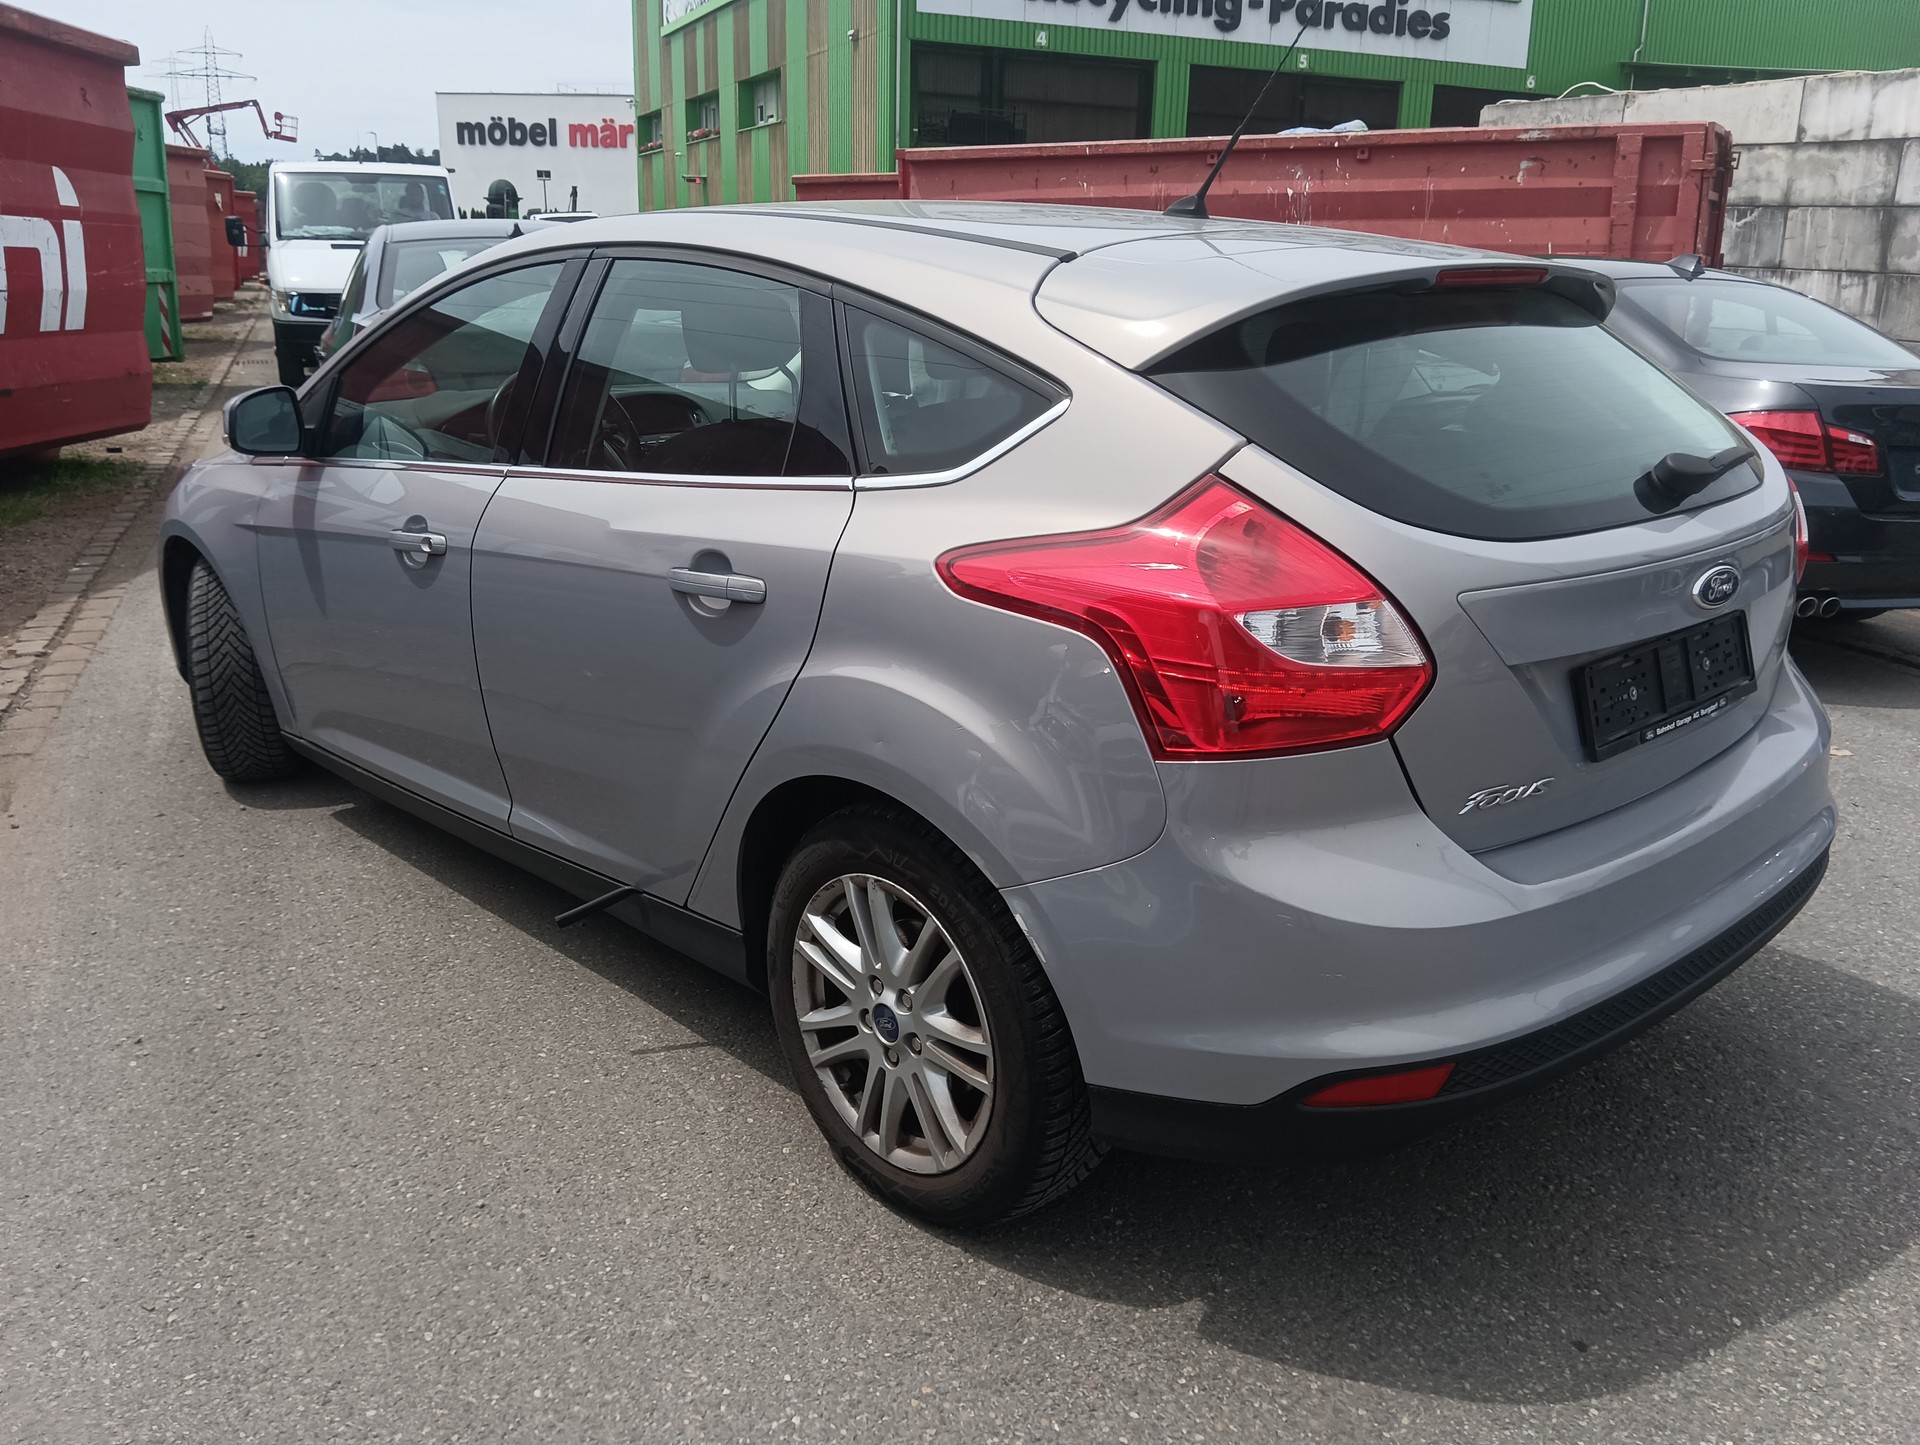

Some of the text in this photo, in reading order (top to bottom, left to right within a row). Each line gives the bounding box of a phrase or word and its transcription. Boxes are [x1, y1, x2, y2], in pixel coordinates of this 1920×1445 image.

[1036, 31, 1047, 46] 4
[1299, 55, 1307, 68] 5
[1526, 75, 1536, 89] 6
[456, 116, 634, 148] möbel mär
[1708, 573, 1734, 600] Ford
[1656, 722, 1676, 735] Bahnhof
[1676, 716, 1692, 727] Garage
[1693, 711, 1700, 719] AG
[1458, 777, 1555, 816] Focus
